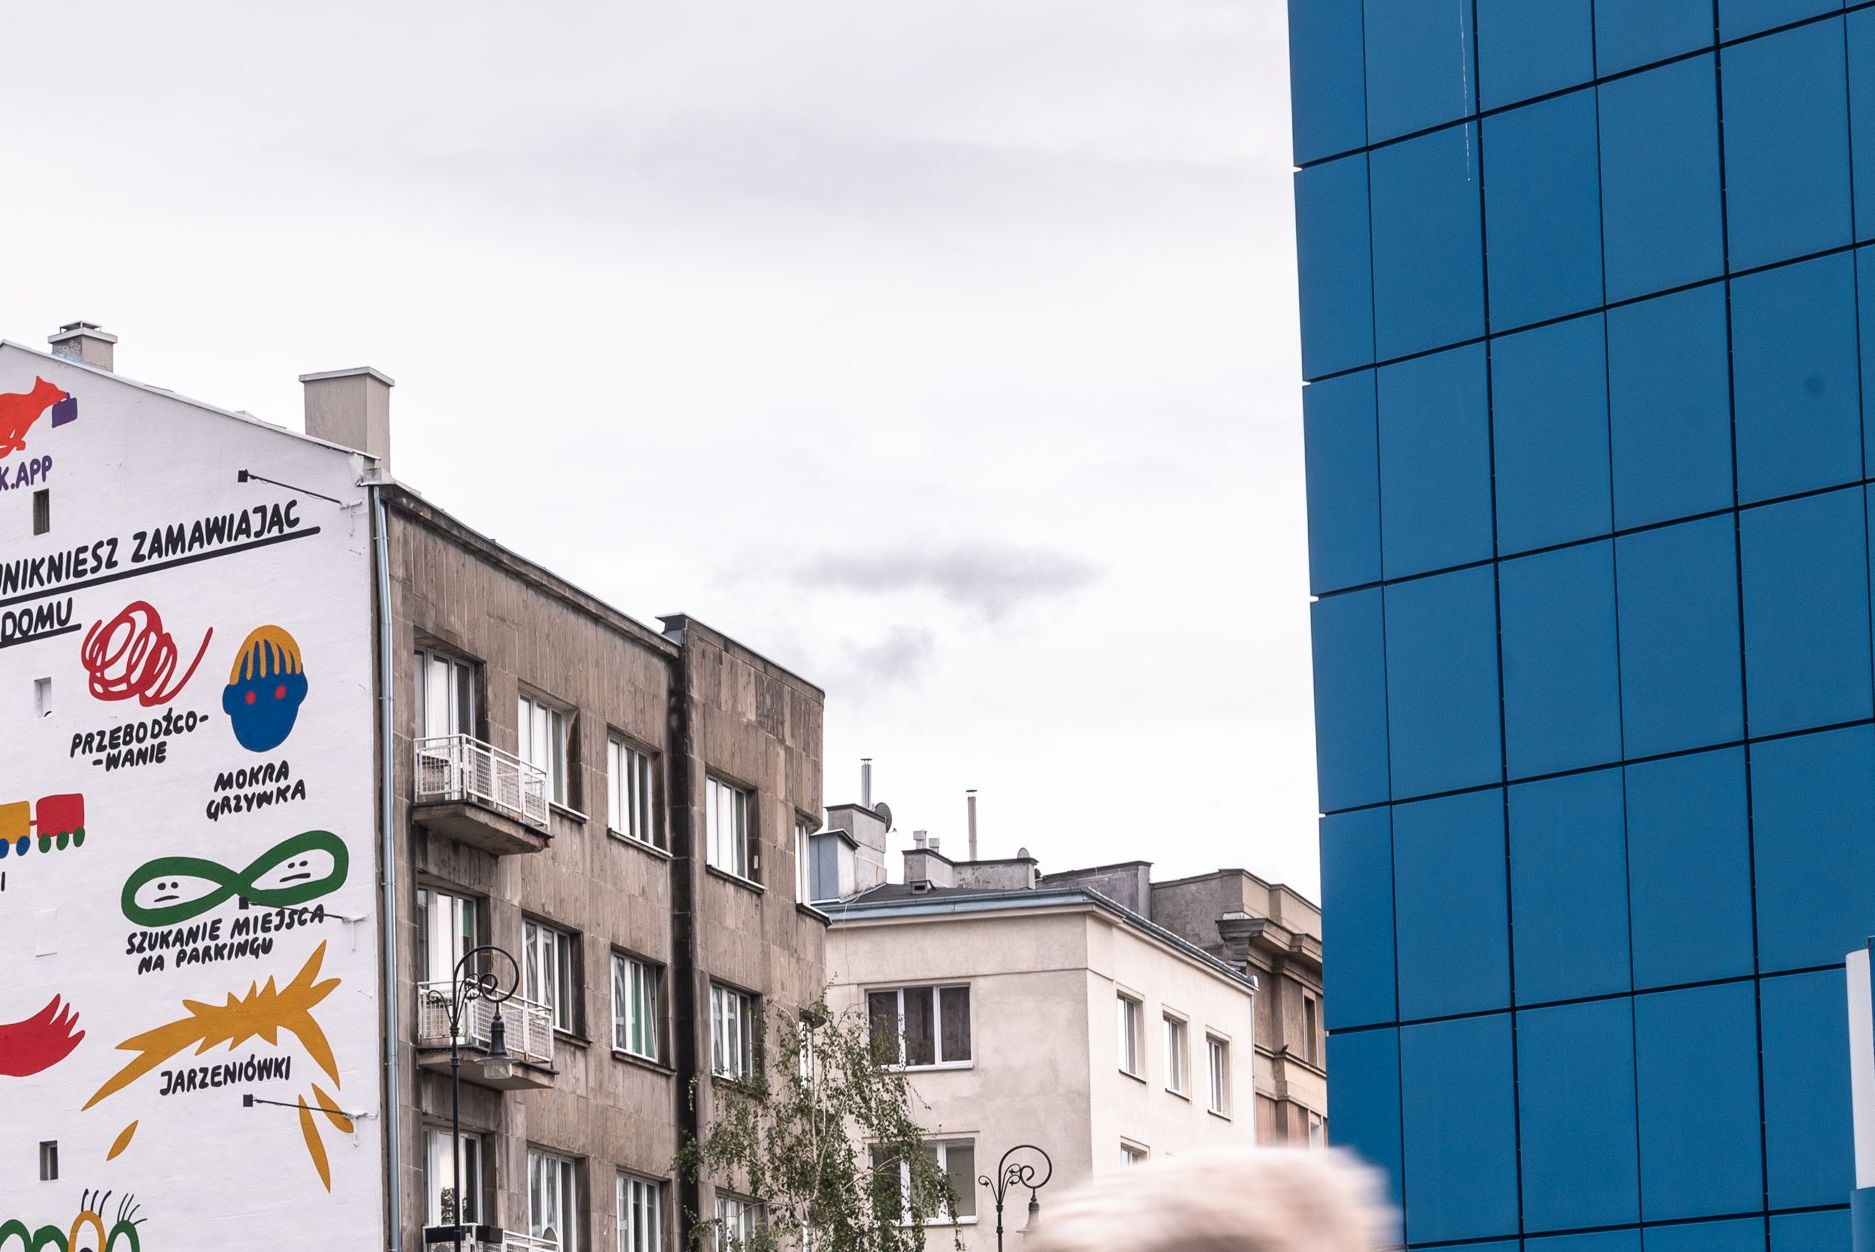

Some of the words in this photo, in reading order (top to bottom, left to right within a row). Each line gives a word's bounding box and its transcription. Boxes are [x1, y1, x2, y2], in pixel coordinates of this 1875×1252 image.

[1, 597, 73, 639] DOMU
[92, 741, 167, 772] -WANIE
[213, 760, 289, 792] MOKRA
[206, 779, 306, 821] GRZYWKA
[125, 918, 222, 955] SZUKANIE
[230, 904, 325, 940] MIEJSCA
[138, 955, 165, 975] NA
[175, 937, 273, 968] PARKINGU
[159, 1054, 291, 1096] JARZENIÓWKI
